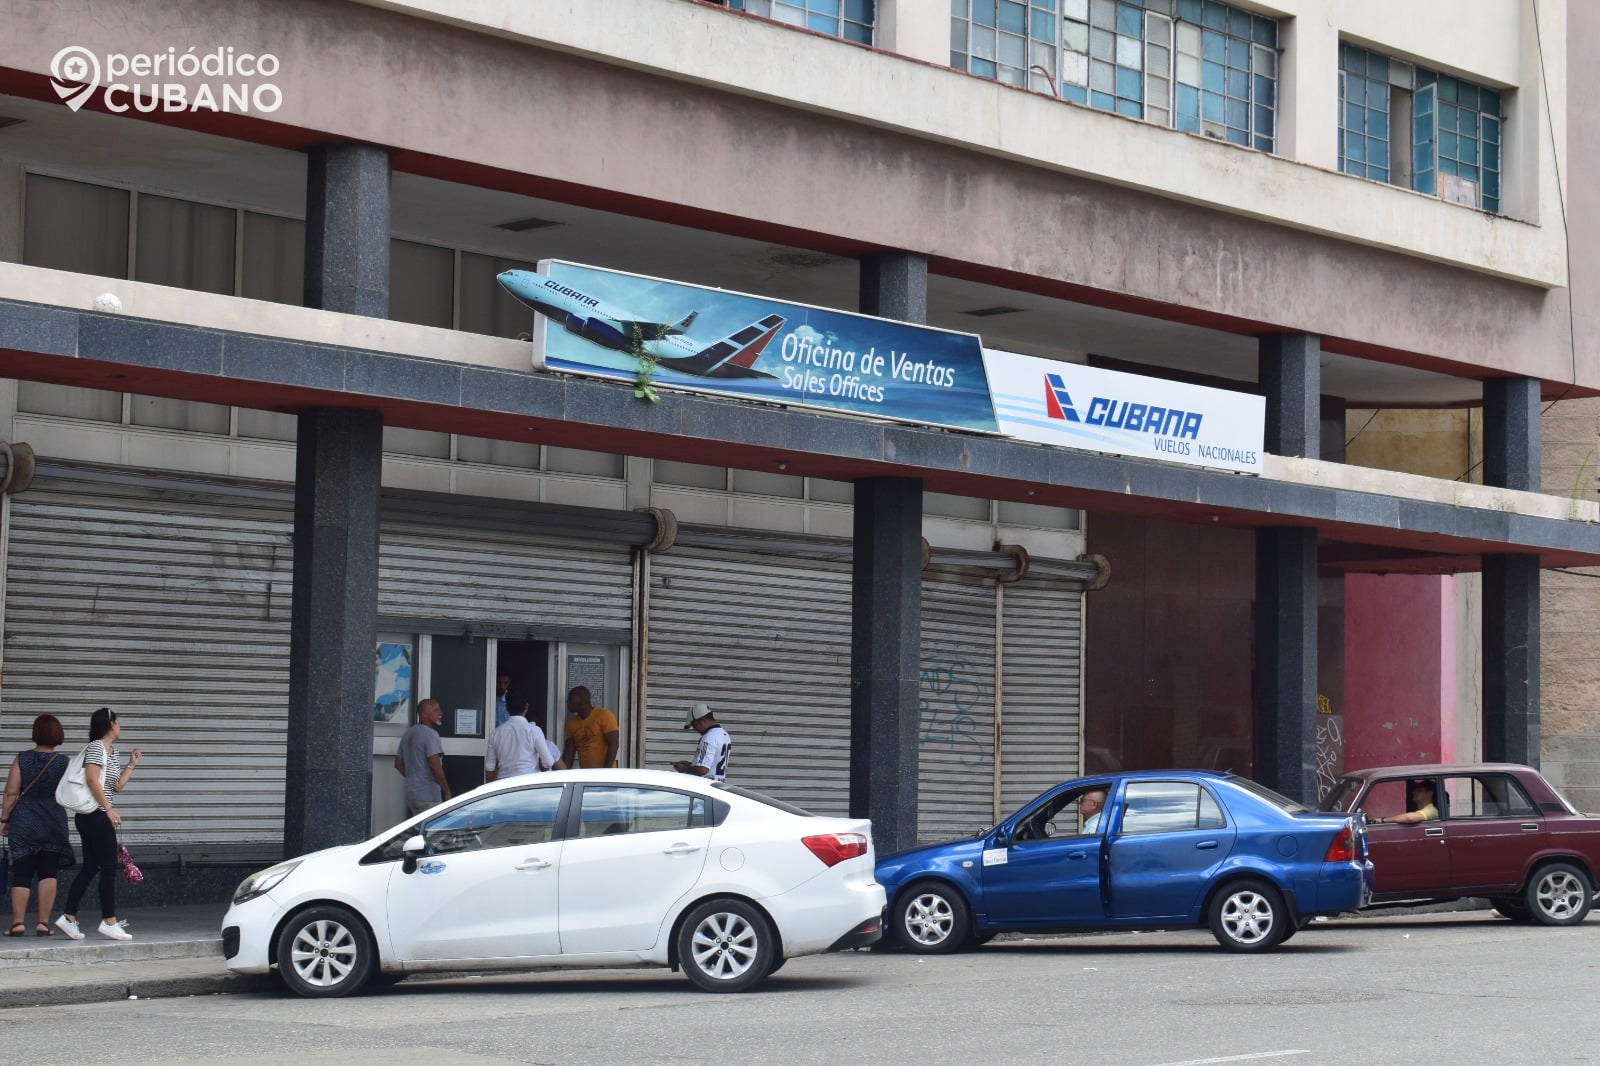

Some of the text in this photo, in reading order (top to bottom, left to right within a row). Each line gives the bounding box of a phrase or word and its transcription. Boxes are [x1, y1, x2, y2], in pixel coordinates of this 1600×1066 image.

[544, 280, 600, 307] CUBANA
[781, 332, 956, 388] Oficina de Ventas
[781, 366, 885, 403] Sales Offices
[1084, 396, 1203, 440] CUBANA
[1153, 437, 1257, 465] VUELOS NACIONALES
